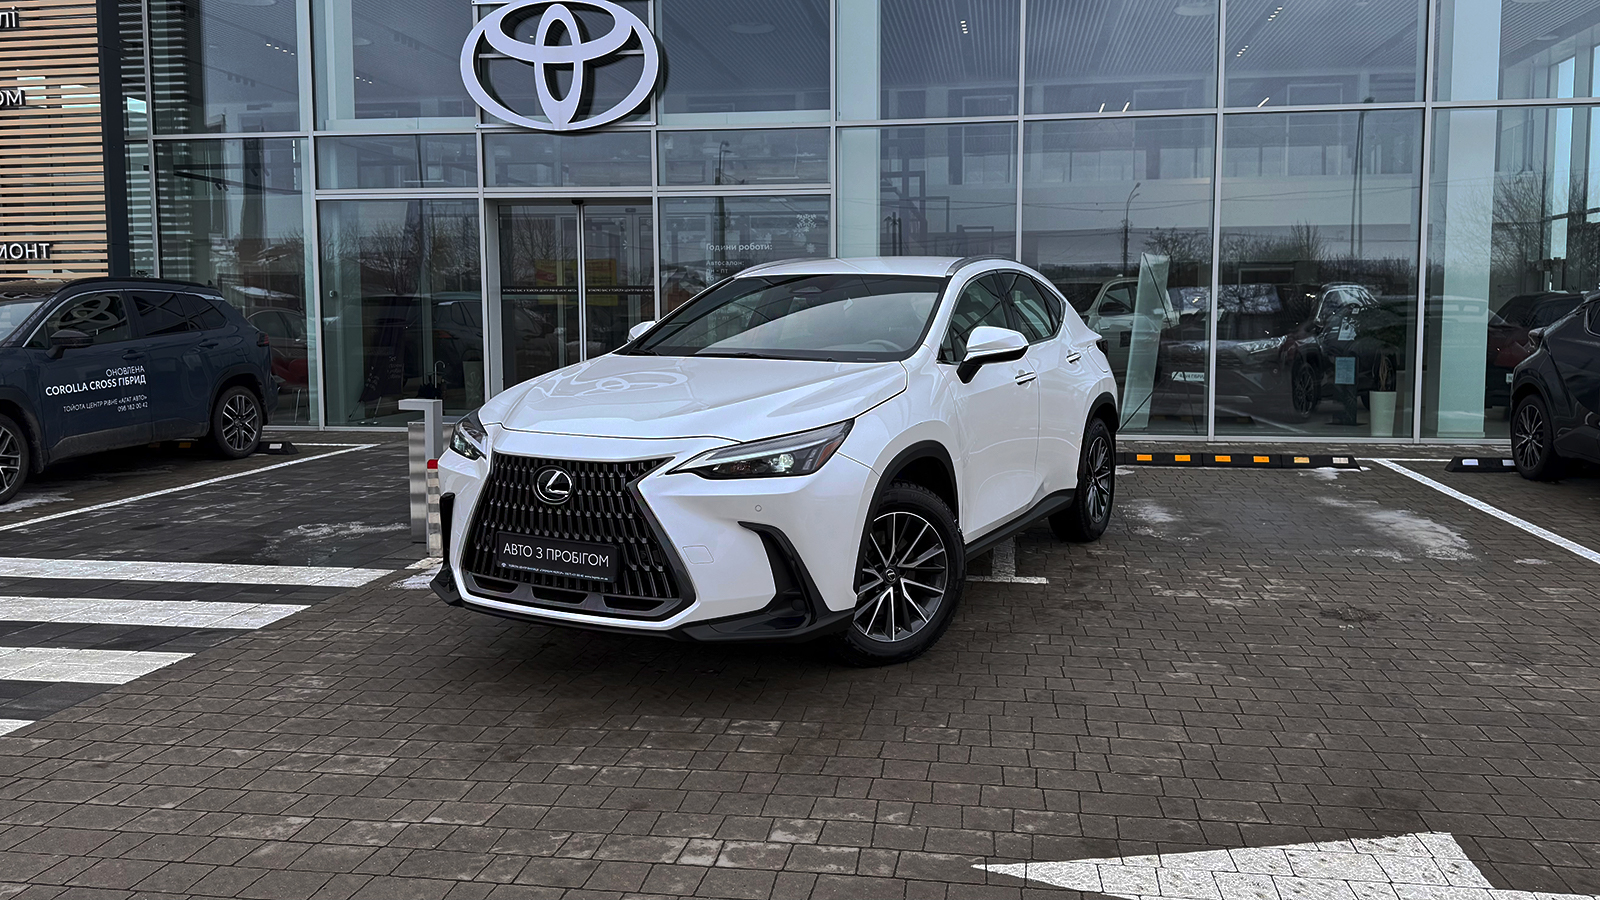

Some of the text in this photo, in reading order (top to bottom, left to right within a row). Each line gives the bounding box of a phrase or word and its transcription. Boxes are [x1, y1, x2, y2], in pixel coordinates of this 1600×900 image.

[706, 242, 773, 252] Години роботи:
[105, 365, 145, 377] ОНОВЛЕНА
[45, 374, 147, 396] COROLLA CROSS ГІБРИД
[503, 542, 533, 558] АВТО
[546, 548, 609, 568] ПРОБІГОМ
